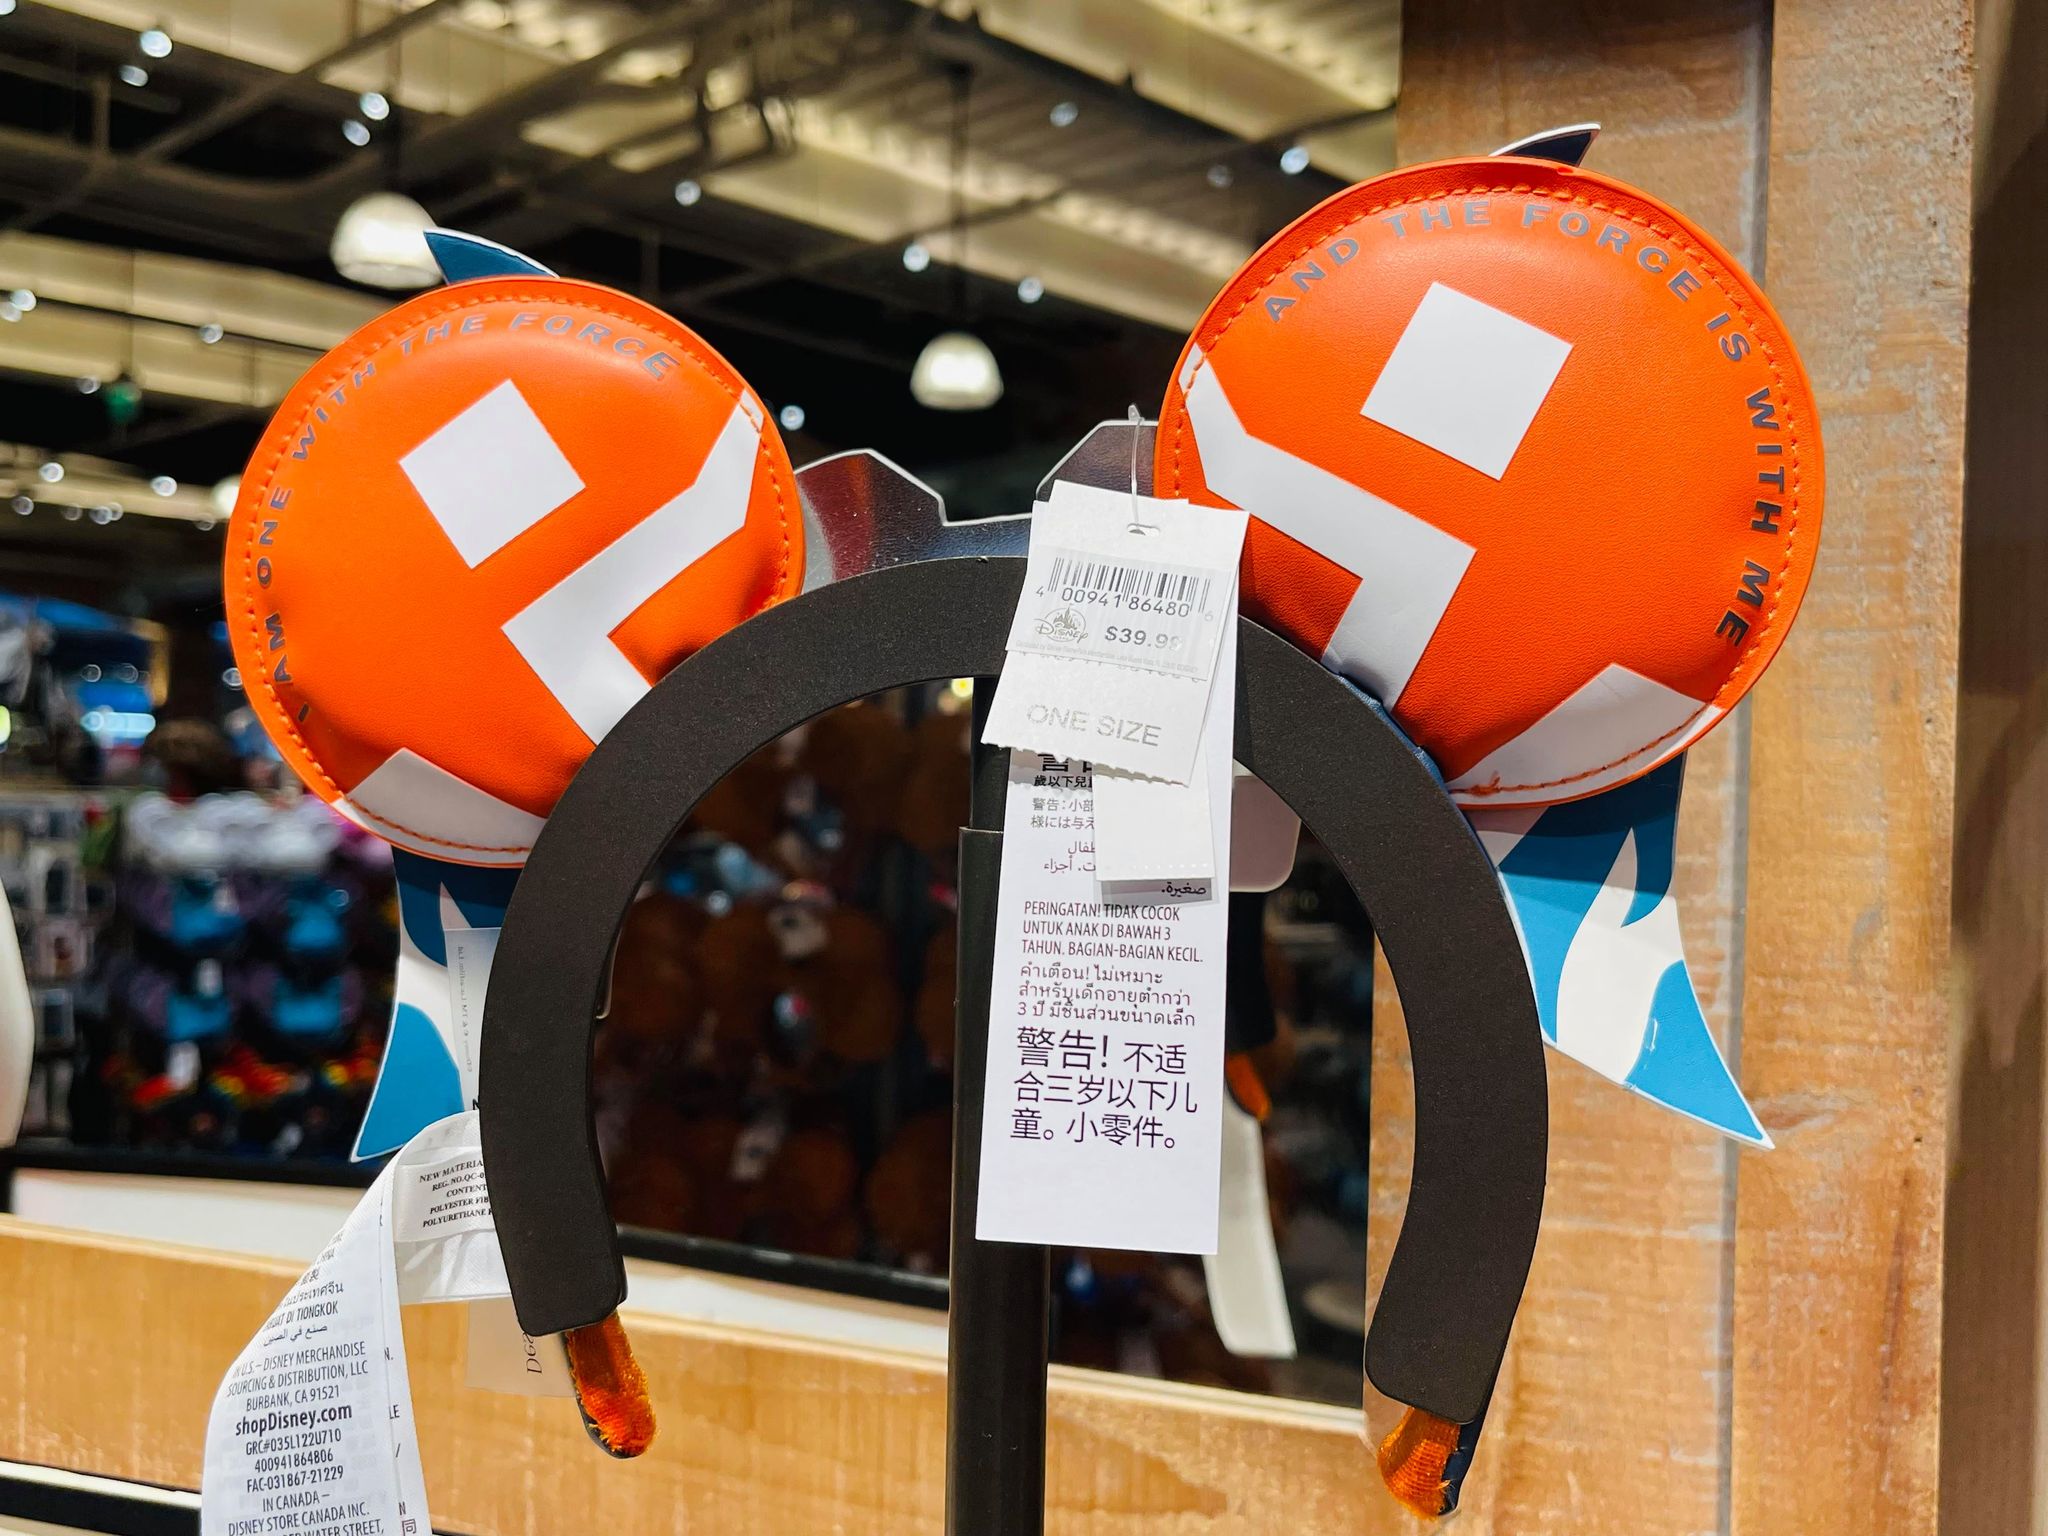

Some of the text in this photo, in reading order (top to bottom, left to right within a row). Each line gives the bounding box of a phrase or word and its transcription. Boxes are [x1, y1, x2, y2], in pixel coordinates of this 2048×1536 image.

[399, 313, 486, 356] THE
[510, 311, 681, 383] FORCE
[292, 361, 378, 461] WITH
[1263, 201, 1786, 648] AND THE FORCE IS WITH ME
[256, 487, 292, 590] ONE
[265, 610, 294, 685] AM
[1026, 703, 1162, 747] ONE SIZE
[1024, 901, 1180, 921] PERINGATAN! TIDAK COCOK
[1023, 920, 1171, 940] UNTUK ANAK DI BAWAH 3
[1022, 939, 1203, 962] TAHUN. BAGIAN-BAGIAN KECIL.
[1017, 1002, 1027, 1016] 3
[1013, 1070, 1198, 1114] 合三岁以下儿
[420, 1171, 441, 1183] NEW
[423, 1209, 486, 1227] POLYURETHANE
[430, 1198, 473, 1214] POLYESTER
[297, 1301, 338, 1320] TIONGKOK
[263, 1353, 294, 1371] DISNEY
[295, 1341, 365, 1366] MERCHANDISE
[227, 1360, 368, 1397] SOURCING & DISTRIBUTION, LLC
[246, 1385, 340, 1412] BURBANK, CA 91521
[235, 1404, 352, 1437] shopDisney.com
[255, 1448, 334, 1474] 400941864806
[246, 1465, 344, 1493] FAC-031867-21229
[262, 1498, 273, 1512] IN
[275, 1491, 320, 1510] CANADA
[228, 1517, 264, 1536] DISNEY
[266, 1513, 300, 1532] STORE
[301, 1506, 346, 1526] CANADA
[347, 1501, 369, 1518] INC.
